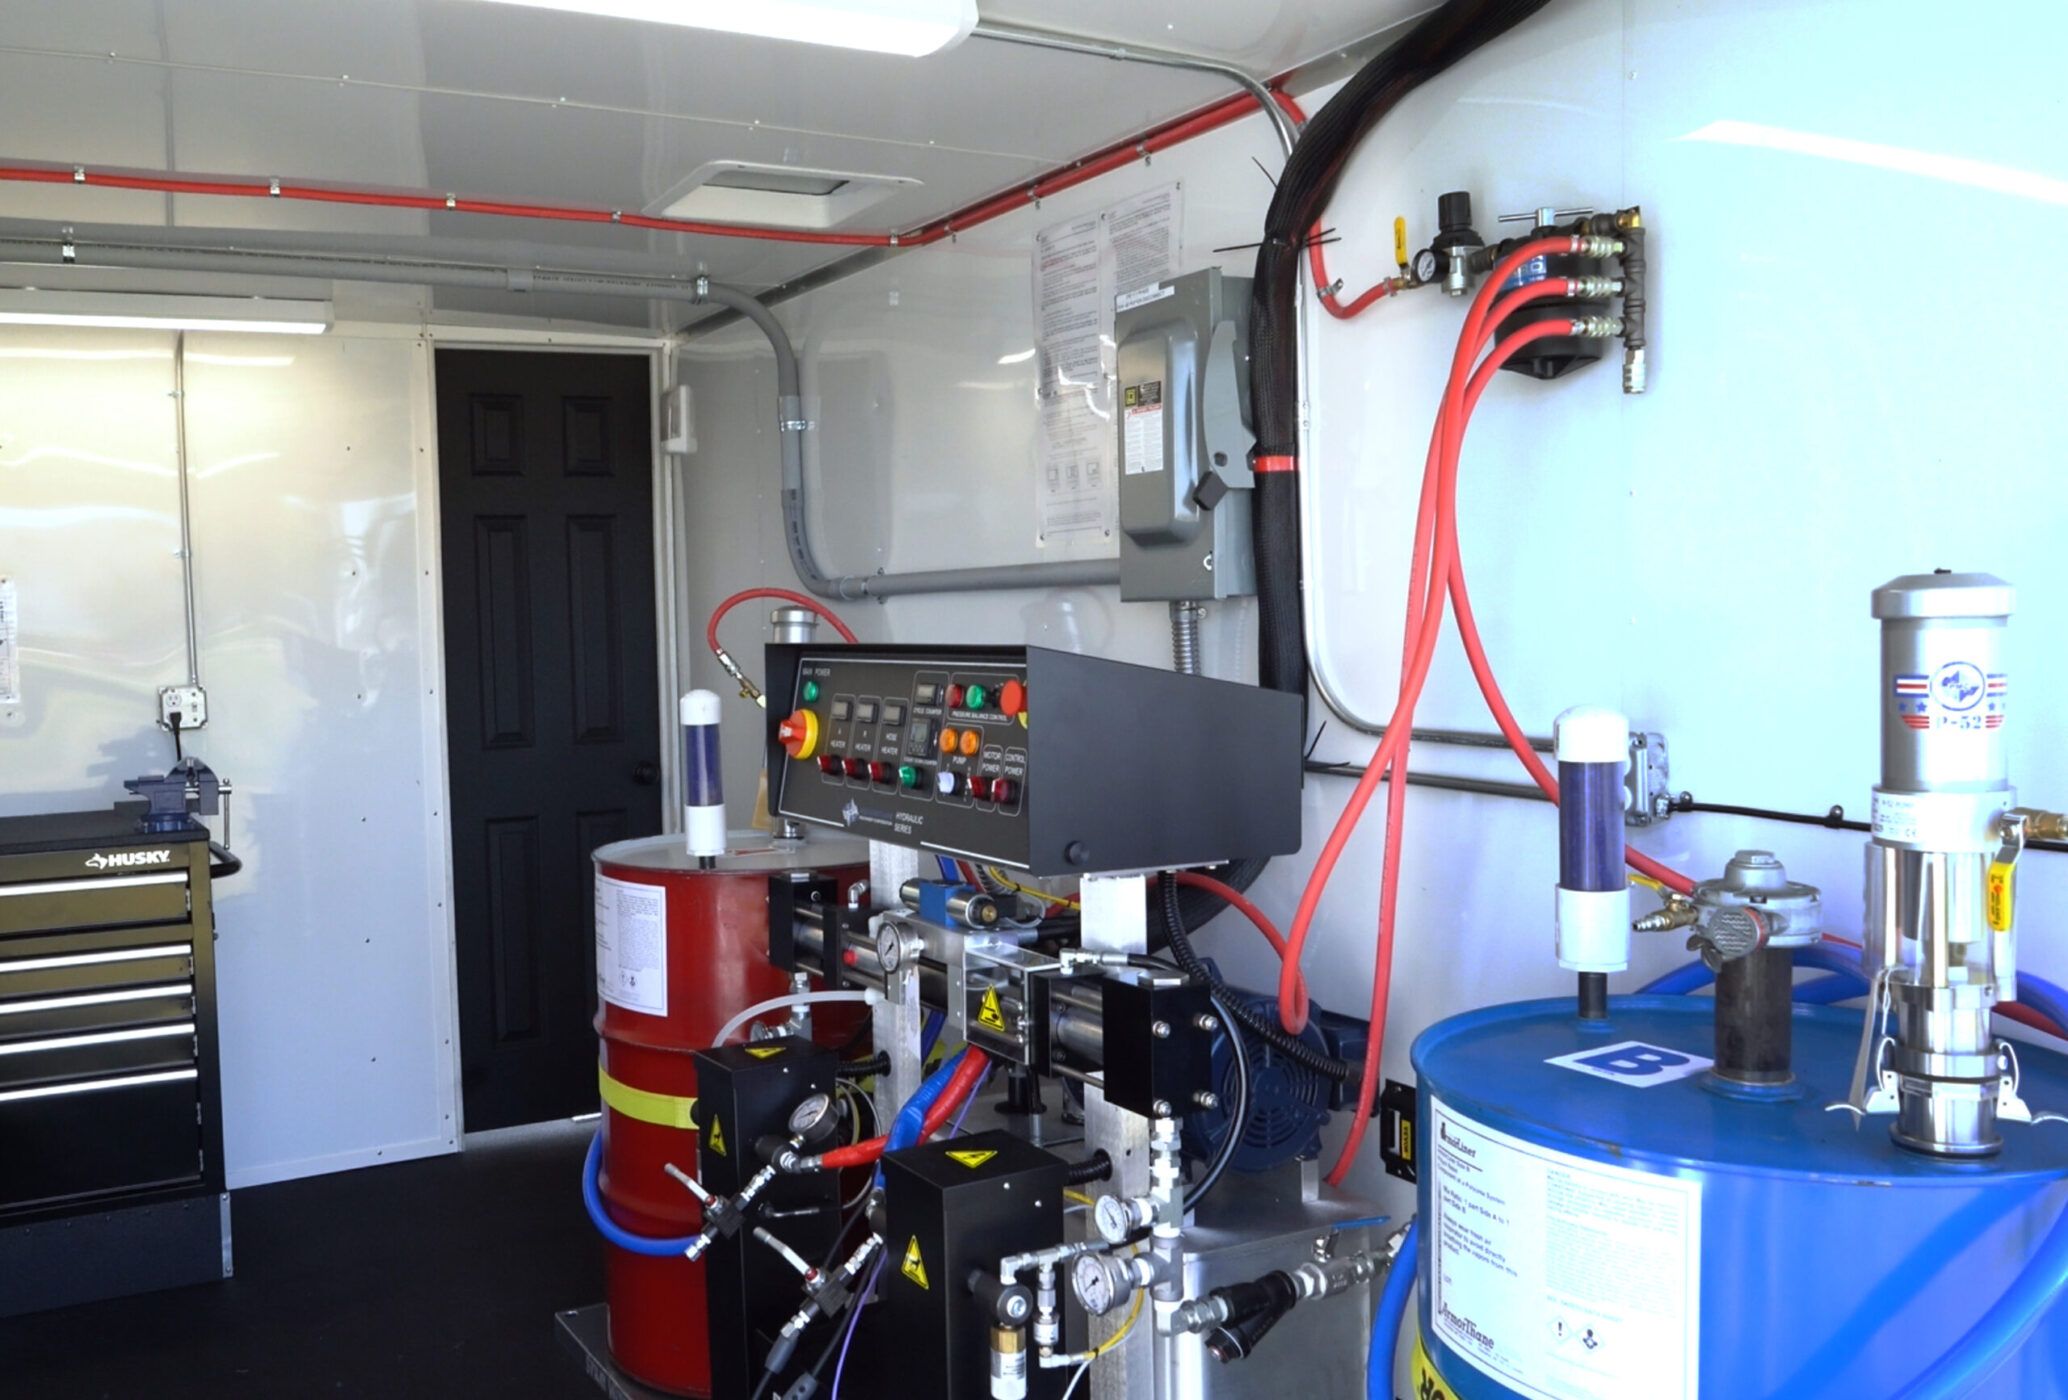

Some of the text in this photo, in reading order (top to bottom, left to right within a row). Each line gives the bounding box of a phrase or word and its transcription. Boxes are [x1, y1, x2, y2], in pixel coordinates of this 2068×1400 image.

[952, 756, 967, 765] PUMP
[895, 811, 924, 825] HYDRAULIC
[894, 822, 912, 835] SERIES
[108, 850, 170, 867] HUSKY
[1573, 1045, 1690, 1076] B
[1439, 1302, 1494, 1349] ArmorThane
